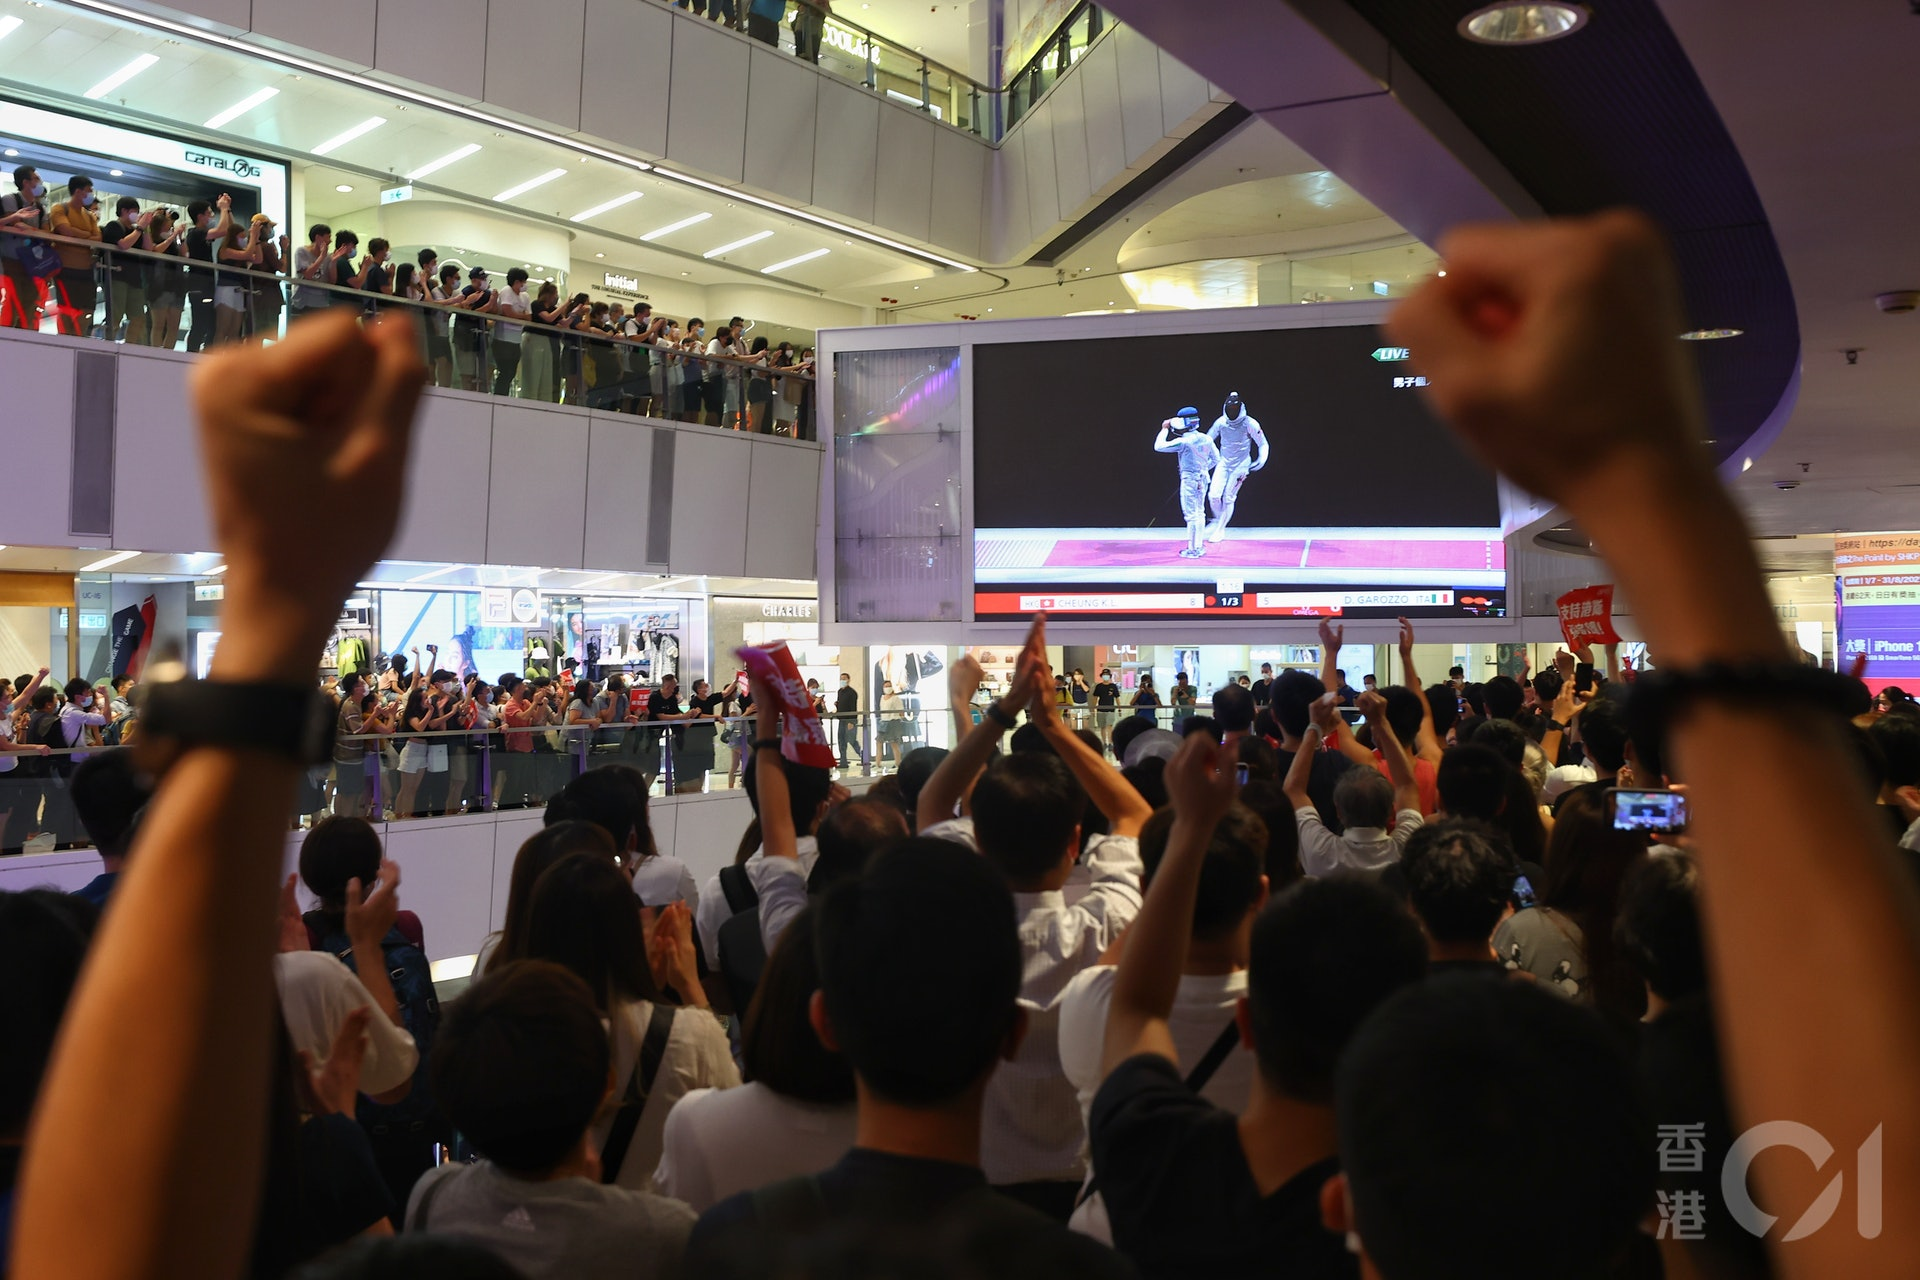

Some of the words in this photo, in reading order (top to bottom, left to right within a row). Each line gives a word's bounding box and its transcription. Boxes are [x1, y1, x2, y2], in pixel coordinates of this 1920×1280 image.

[605, 272, 638, 291] initial
[1380, 348, 1410, 360] LIVE
[1058, 599, 1099, 607] CHEUNG
[1221, 597, 1239, 606] 1/3
[1357, 595, 1409, 604] GAROZZO
[762, 604, 812, 617] CHARLES
[123, 617, 135, 636] GAME
[1874, 640, 1914, 652] iPhone
